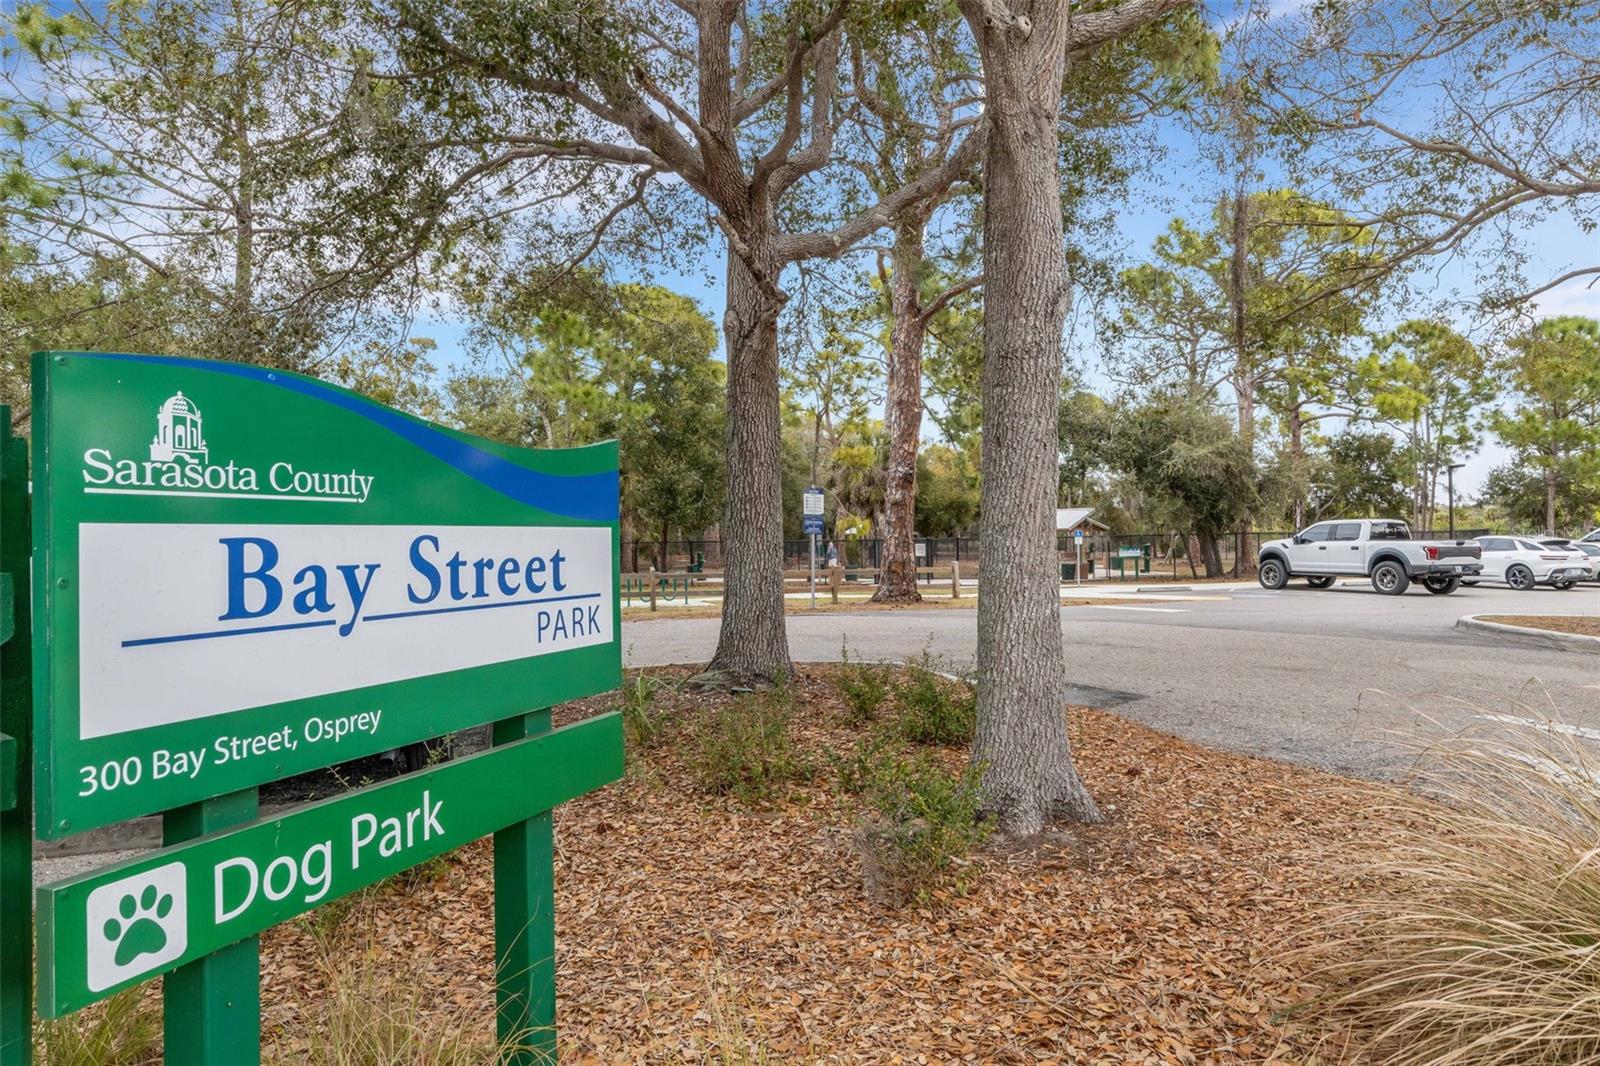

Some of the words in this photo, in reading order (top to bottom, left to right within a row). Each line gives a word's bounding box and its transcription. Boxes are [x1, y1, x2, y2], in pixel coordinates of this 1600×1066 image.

[82, 448, 259, 491] Sarasota
[269, 462, 374, 503] County
[218, 537, 381, 637] Bay
[407, 534, 566, 604] Street
[537, 605, 601, 643] PARK
[79, 756, 142, 796] 300
[152, 749, 206, 779] Bay
[214, 725, 298, 764] Street,
[304, 709, 382, 742] Osprey
[214, 840, 332, 925] Dog
[352, 790, 445, 870] Park
